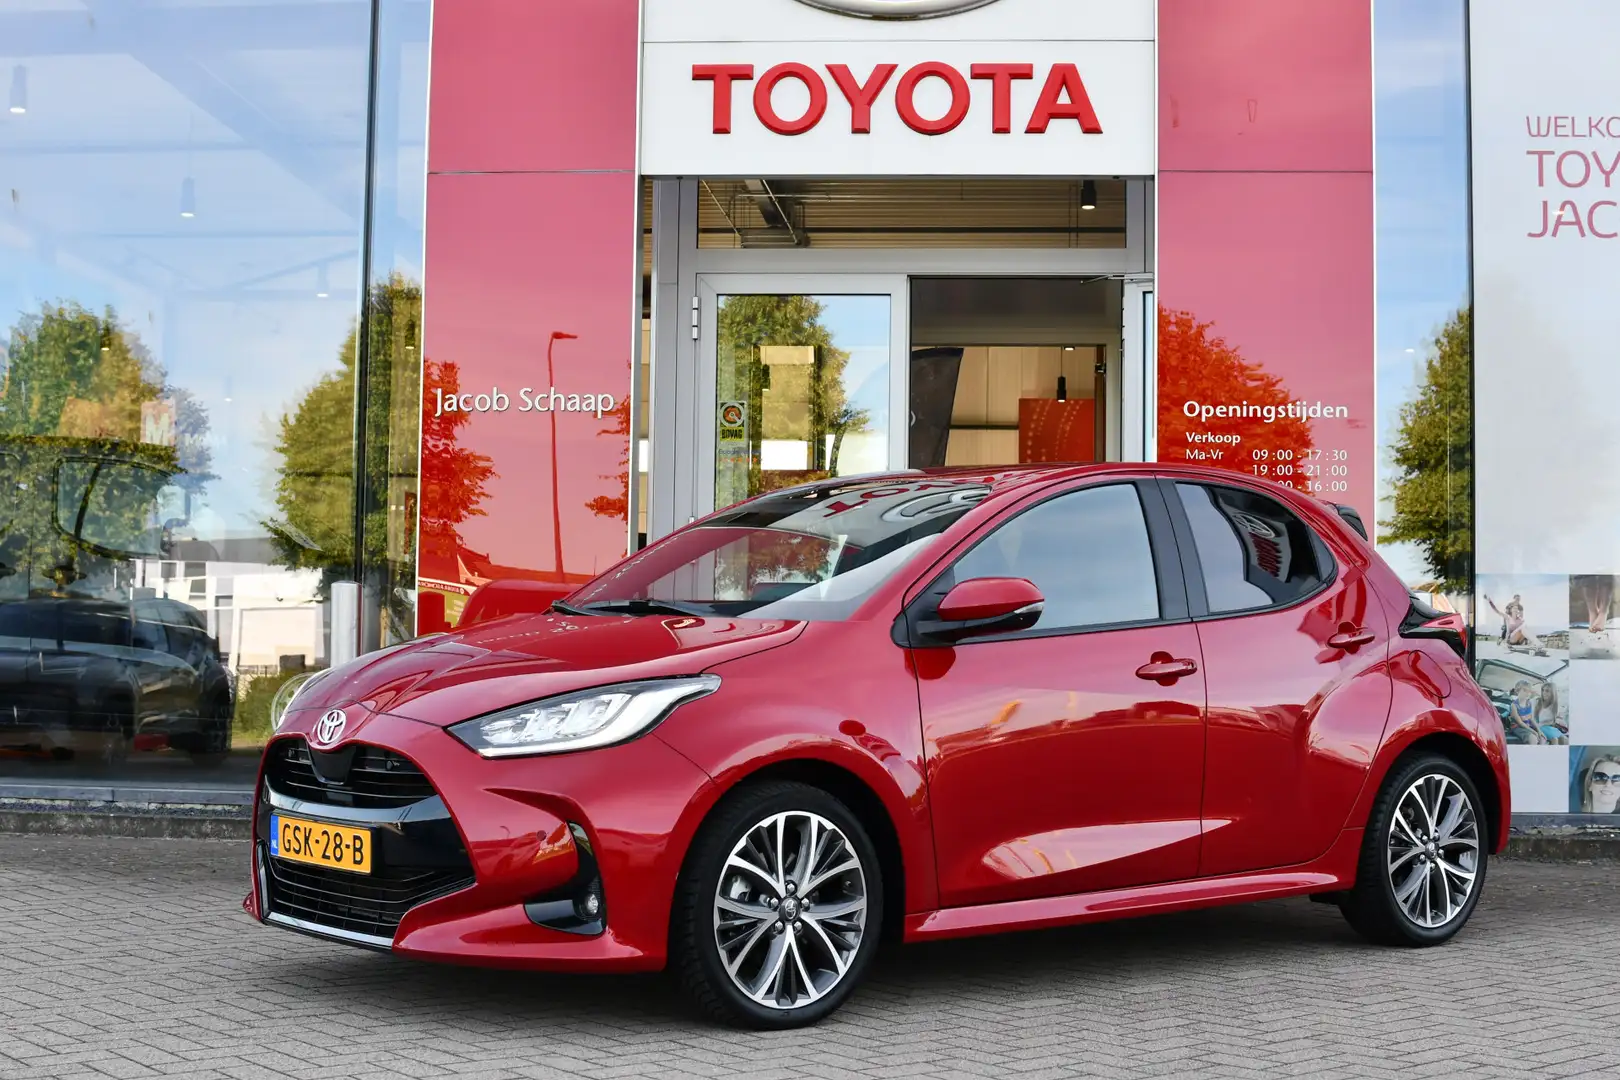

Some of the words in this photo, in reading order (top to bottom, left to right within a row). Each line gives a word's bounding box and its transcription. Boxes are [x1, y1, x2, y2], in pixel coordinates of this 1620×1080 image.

[692, 61, 1103, 136] TOYOTA
[1526, 150, 1620, 188] TOY
[1527, 200, 1618, 238] JAC
[434, 387, 510, 417] Jacob
[518, 387, 615, 419] Schaap
[1183, 400, 1348, 423] Openingstijden
[1185, 432, 1241, 446] Verkoop
[1185, 449, 1224, 460] Ma-Vr
[282, 823, 364, 865] GSK-28-B
